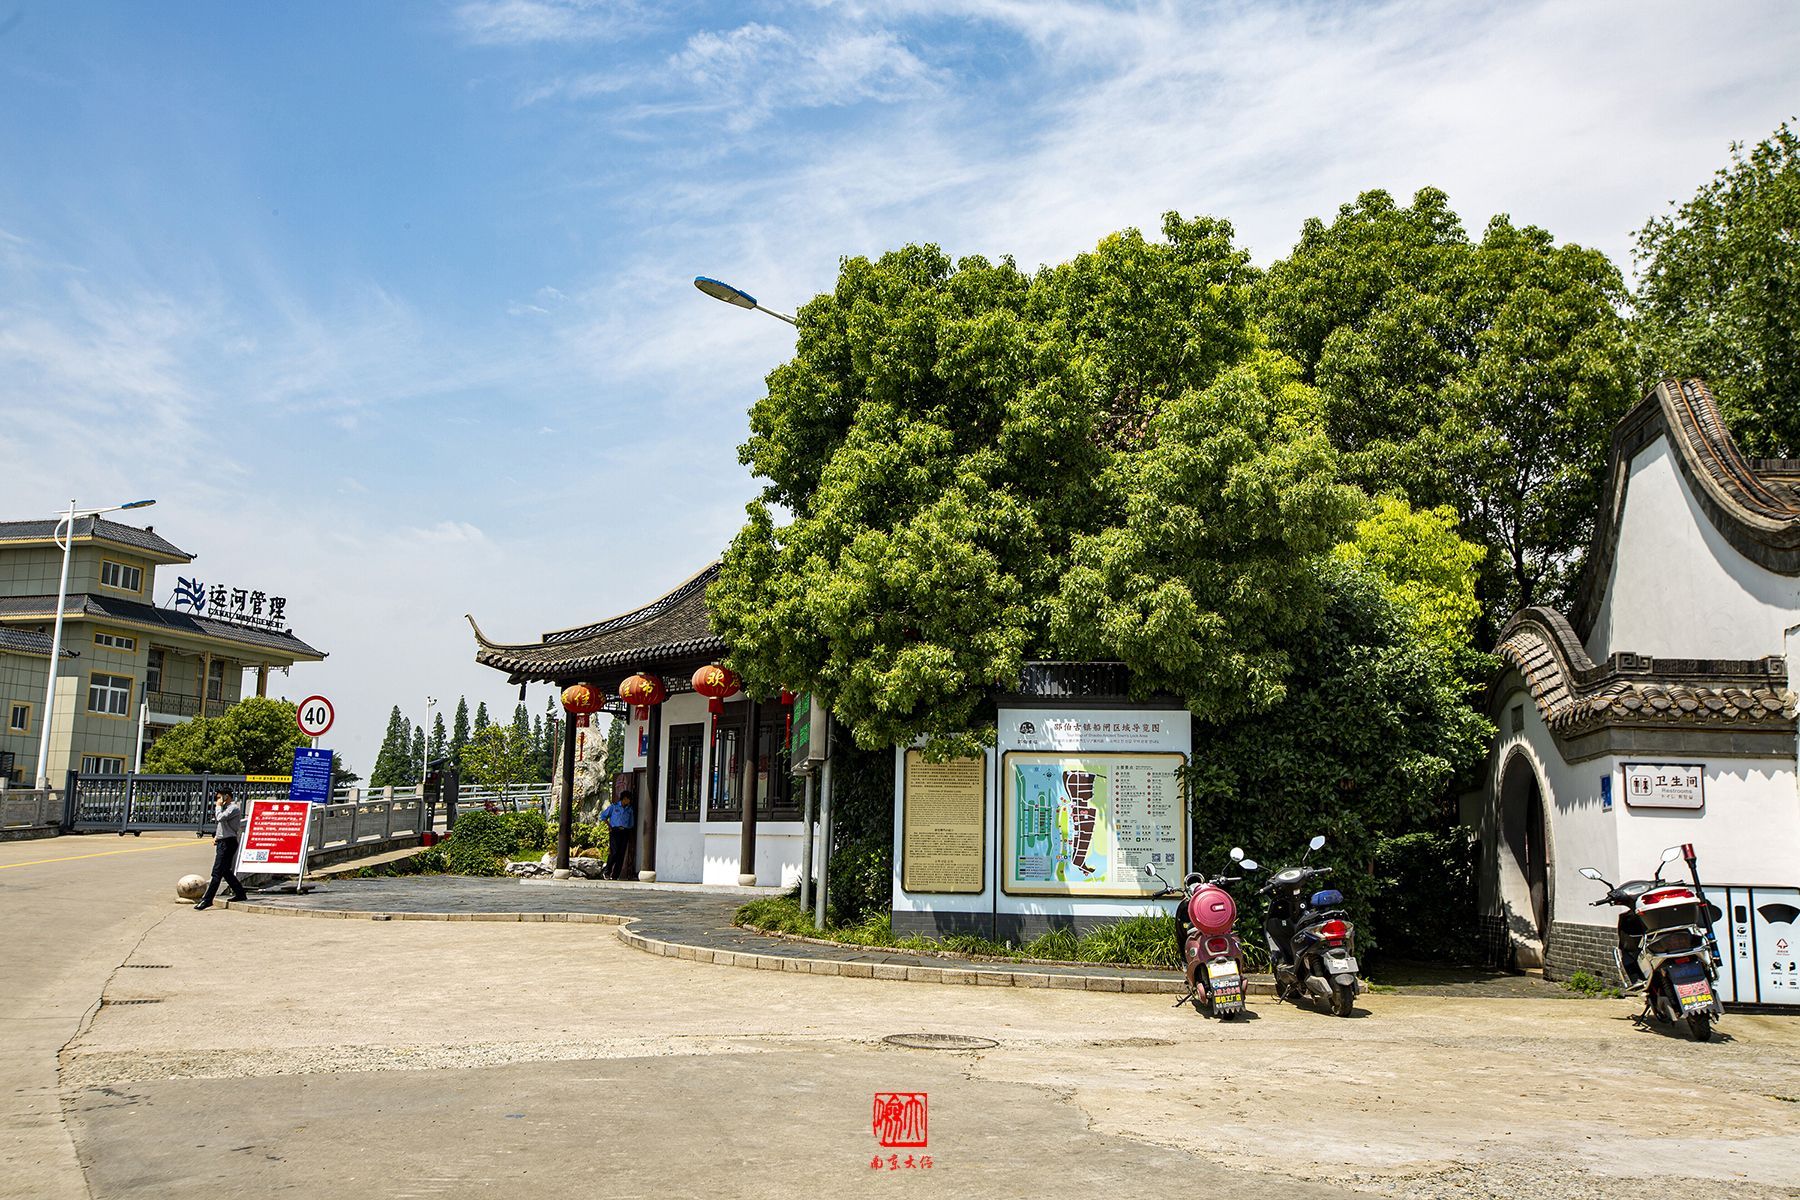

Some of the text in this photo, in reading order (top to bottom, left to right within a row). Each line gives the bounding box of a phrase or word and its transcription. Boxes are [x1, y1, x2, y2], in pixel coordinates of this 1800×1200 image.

[209, 584, 287, 619] 运河管理
[208, 608, 233, 619] CANAL
[305, 707, 326, 726] 40
[1655, 775, 1698, 788] 卫生间
